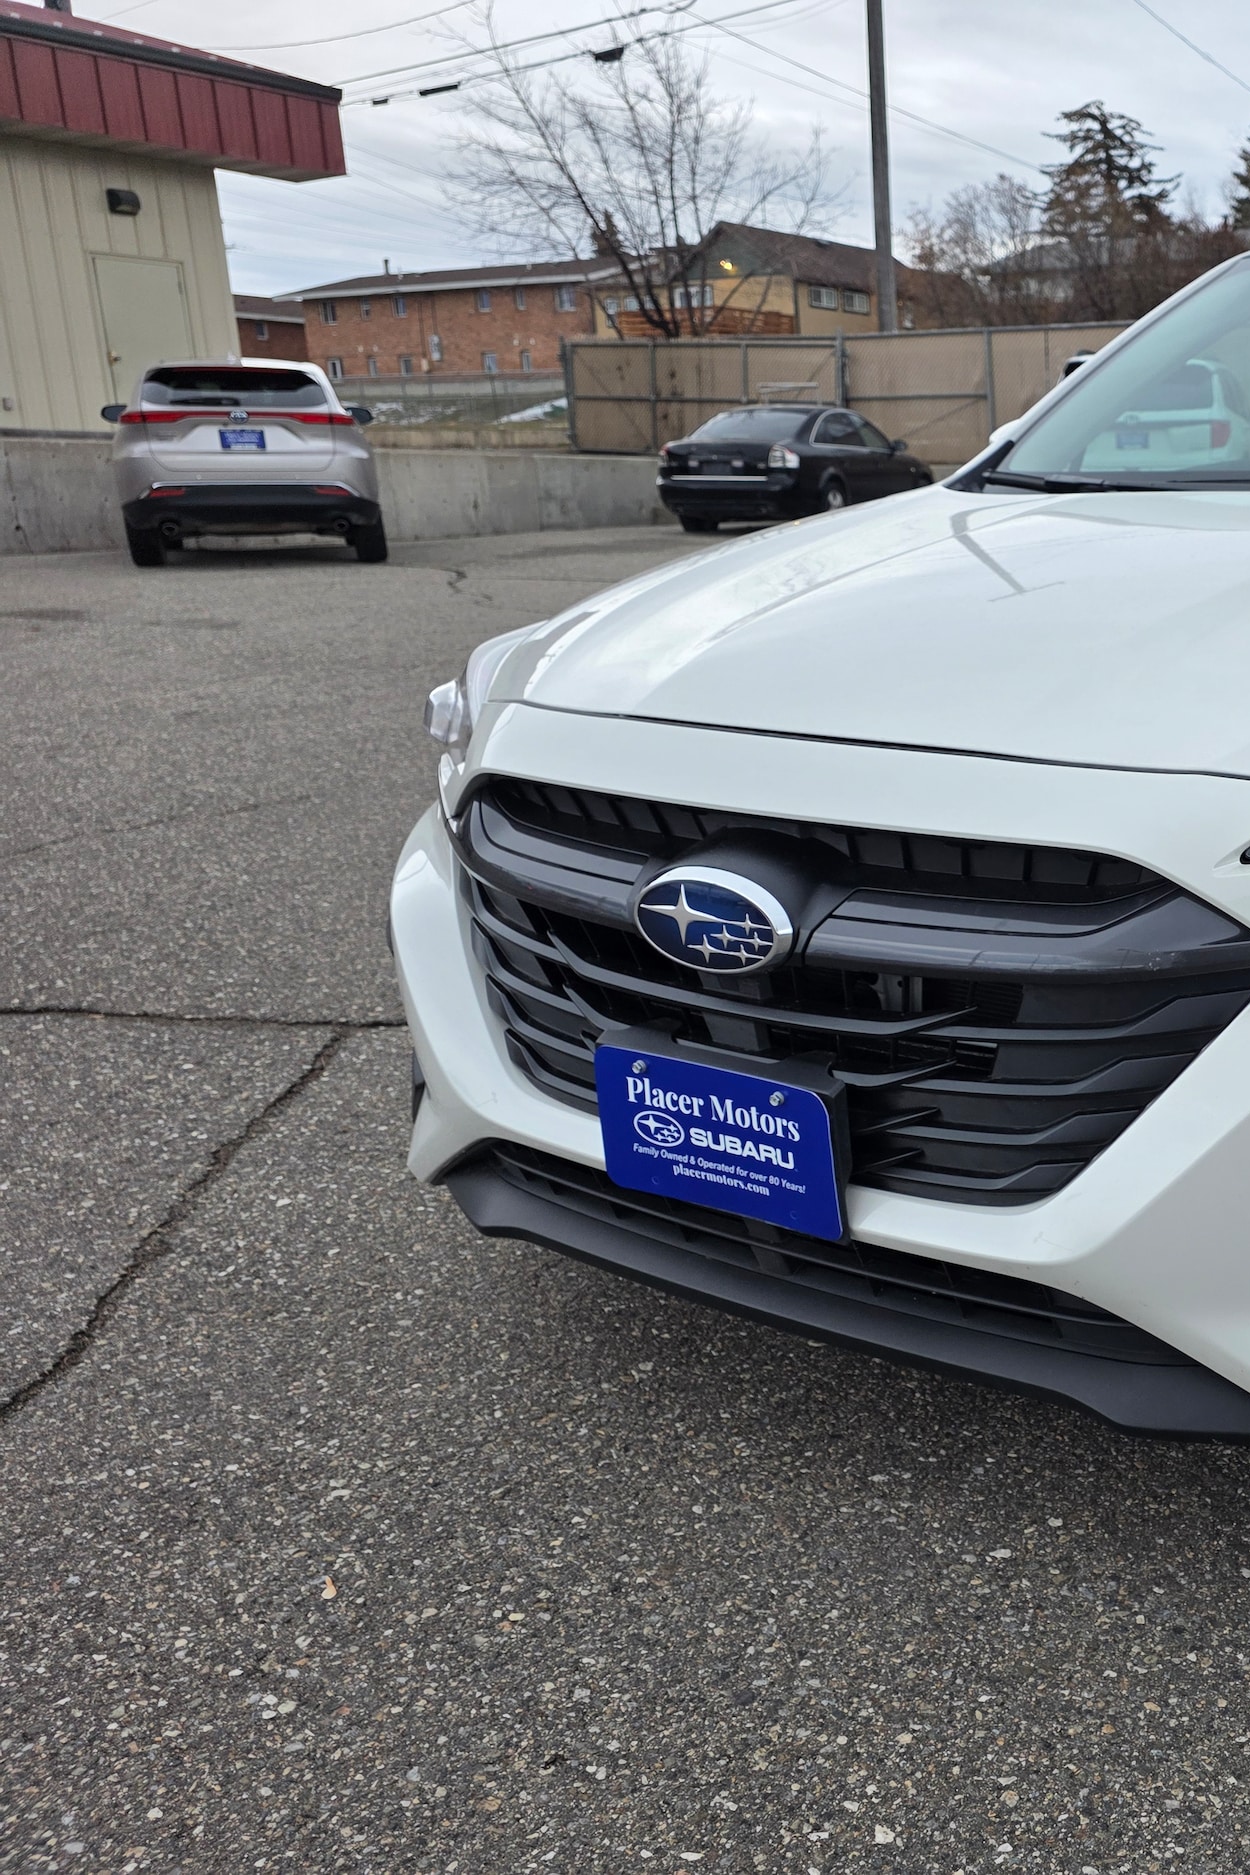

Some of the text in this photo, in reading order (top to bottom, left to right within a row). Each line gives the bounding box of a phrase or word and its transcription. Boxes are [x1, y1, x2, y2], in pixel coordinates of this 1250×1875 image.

[626, 1076, 801, 1142] Placer Motors
[633, 1143, 806, 1194] Family Owned & Operated for over 80 Years!
[689, 1127, 795, 1169] SUBARU
[672, 1163, 770, 1196] placermotors.com
